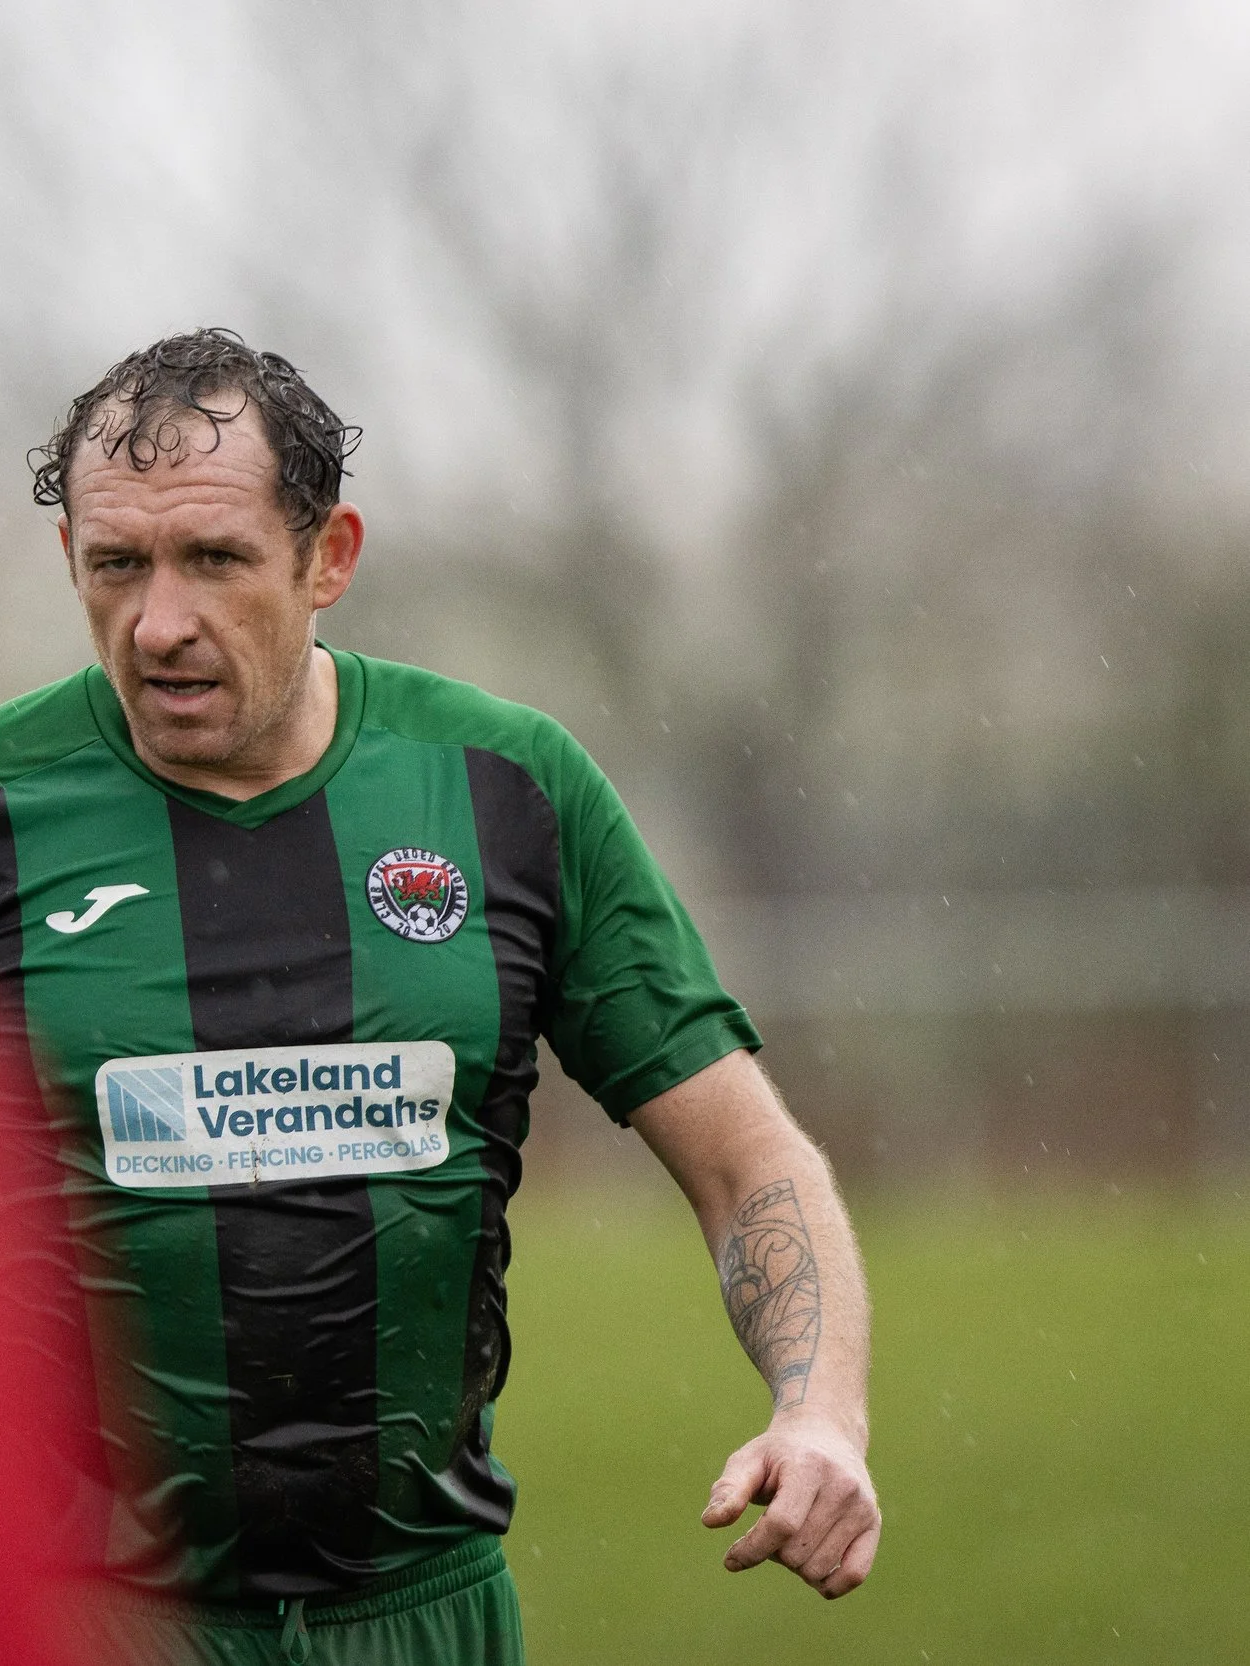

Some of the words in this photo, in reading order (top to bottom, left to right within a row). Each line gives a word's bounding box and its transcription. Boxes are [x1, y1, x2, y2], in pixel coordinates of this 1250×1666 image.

[193, 1055, 401, 1099] Lakeland
[197, 1095, 440, 1139] Verandahs
[116, 1153, 213, 1174] DECKING
[228, 1145, 323, 1167] FENCING
[338, 1134, 442, 1161] PERGOLAS
